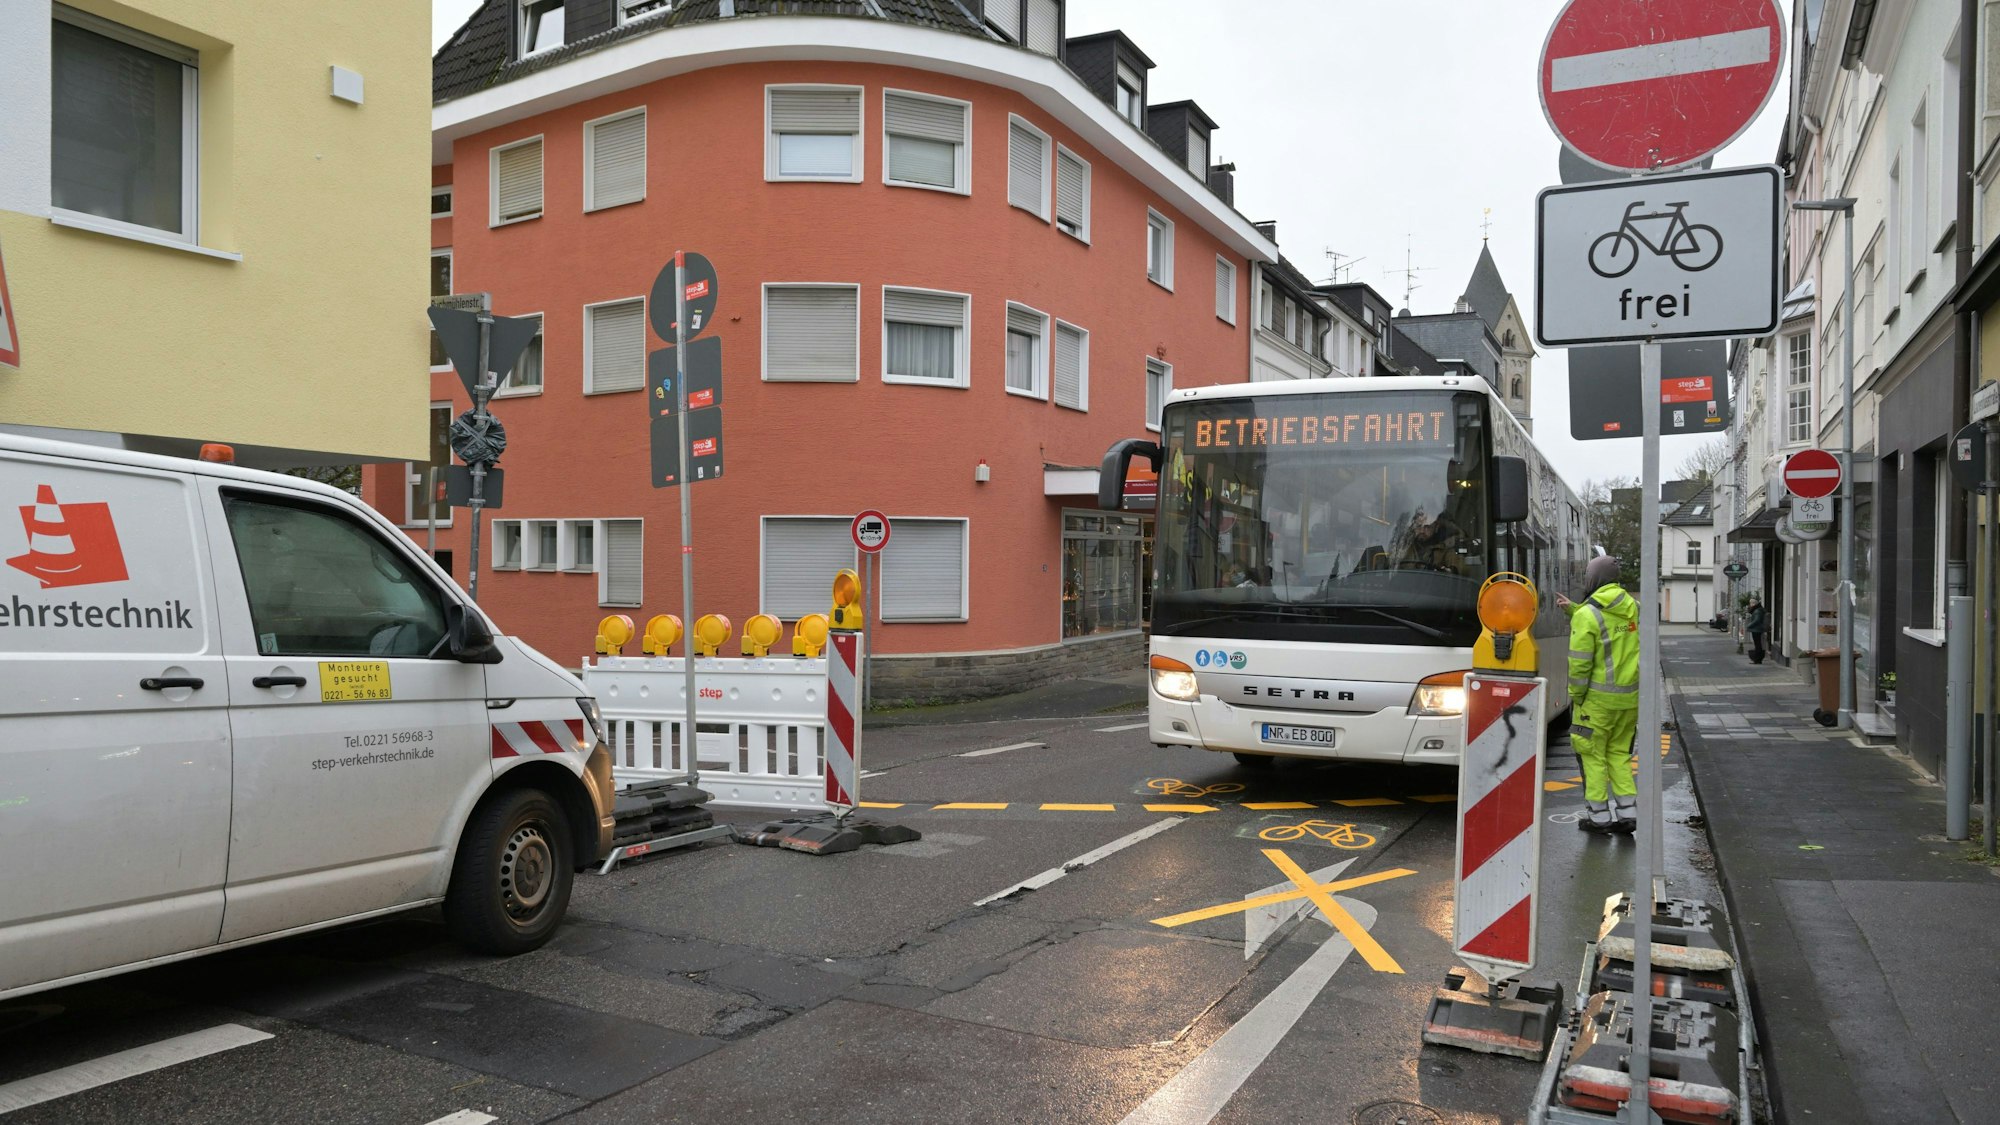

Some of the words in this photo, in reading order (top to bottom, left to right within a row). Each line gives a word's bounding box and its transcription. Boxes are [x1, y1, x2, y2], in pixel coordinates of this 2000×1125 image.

[1619, 284, 1690, 320] frei
[1196, 411, 1445, 447] BETRIEBSFAHRT
[328, 664, 380, 672] Monteure
[334, 674, 378, 685] gesucht
[325, 690, 344, 700] 0221
[353, 689, 364, 698] 56
[366, 689, 377, 698] 96
[379, 688, 389, 697] 83
[699, 687, 723, 700] step
[1243, 685, 1354, 701] SETRA
[392, 730, 434, 744] 56968-3
[1269, 727, 1284, 740] NR
[1292, 728, 1307, 741] EB
[1310, 729, 1333, 743] 800
[311, 747, 434, 771] step-verkehrstechnik.de
